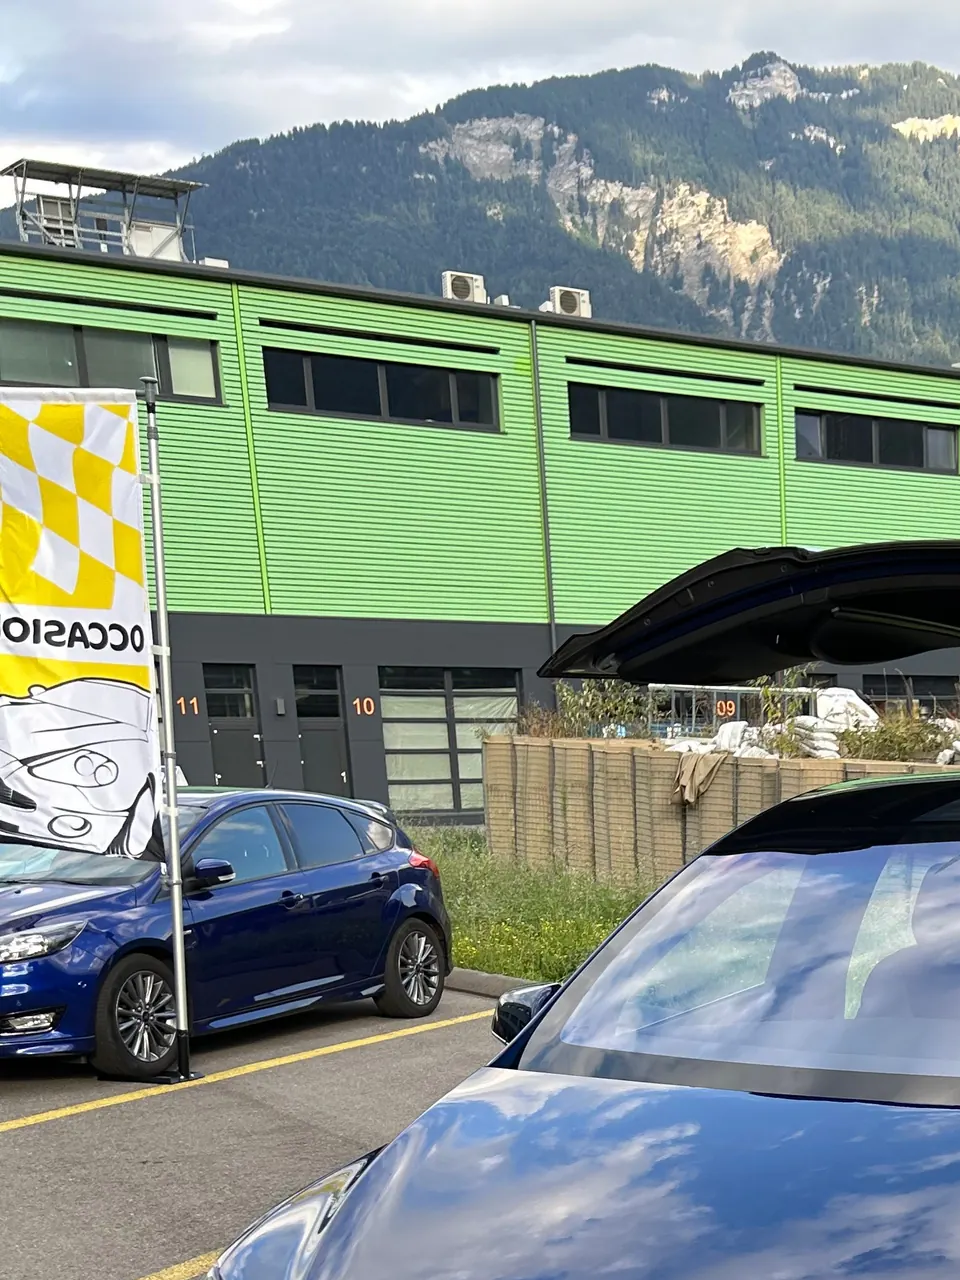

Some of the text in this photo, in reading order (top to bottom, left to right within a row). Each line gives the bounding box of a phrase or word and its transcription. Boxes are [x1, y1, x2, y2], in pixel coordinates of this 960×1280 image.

[176, 696, 199, 715] 11
[352, 697, 375, 716] 10
[716, 700, 736, 717] 09
